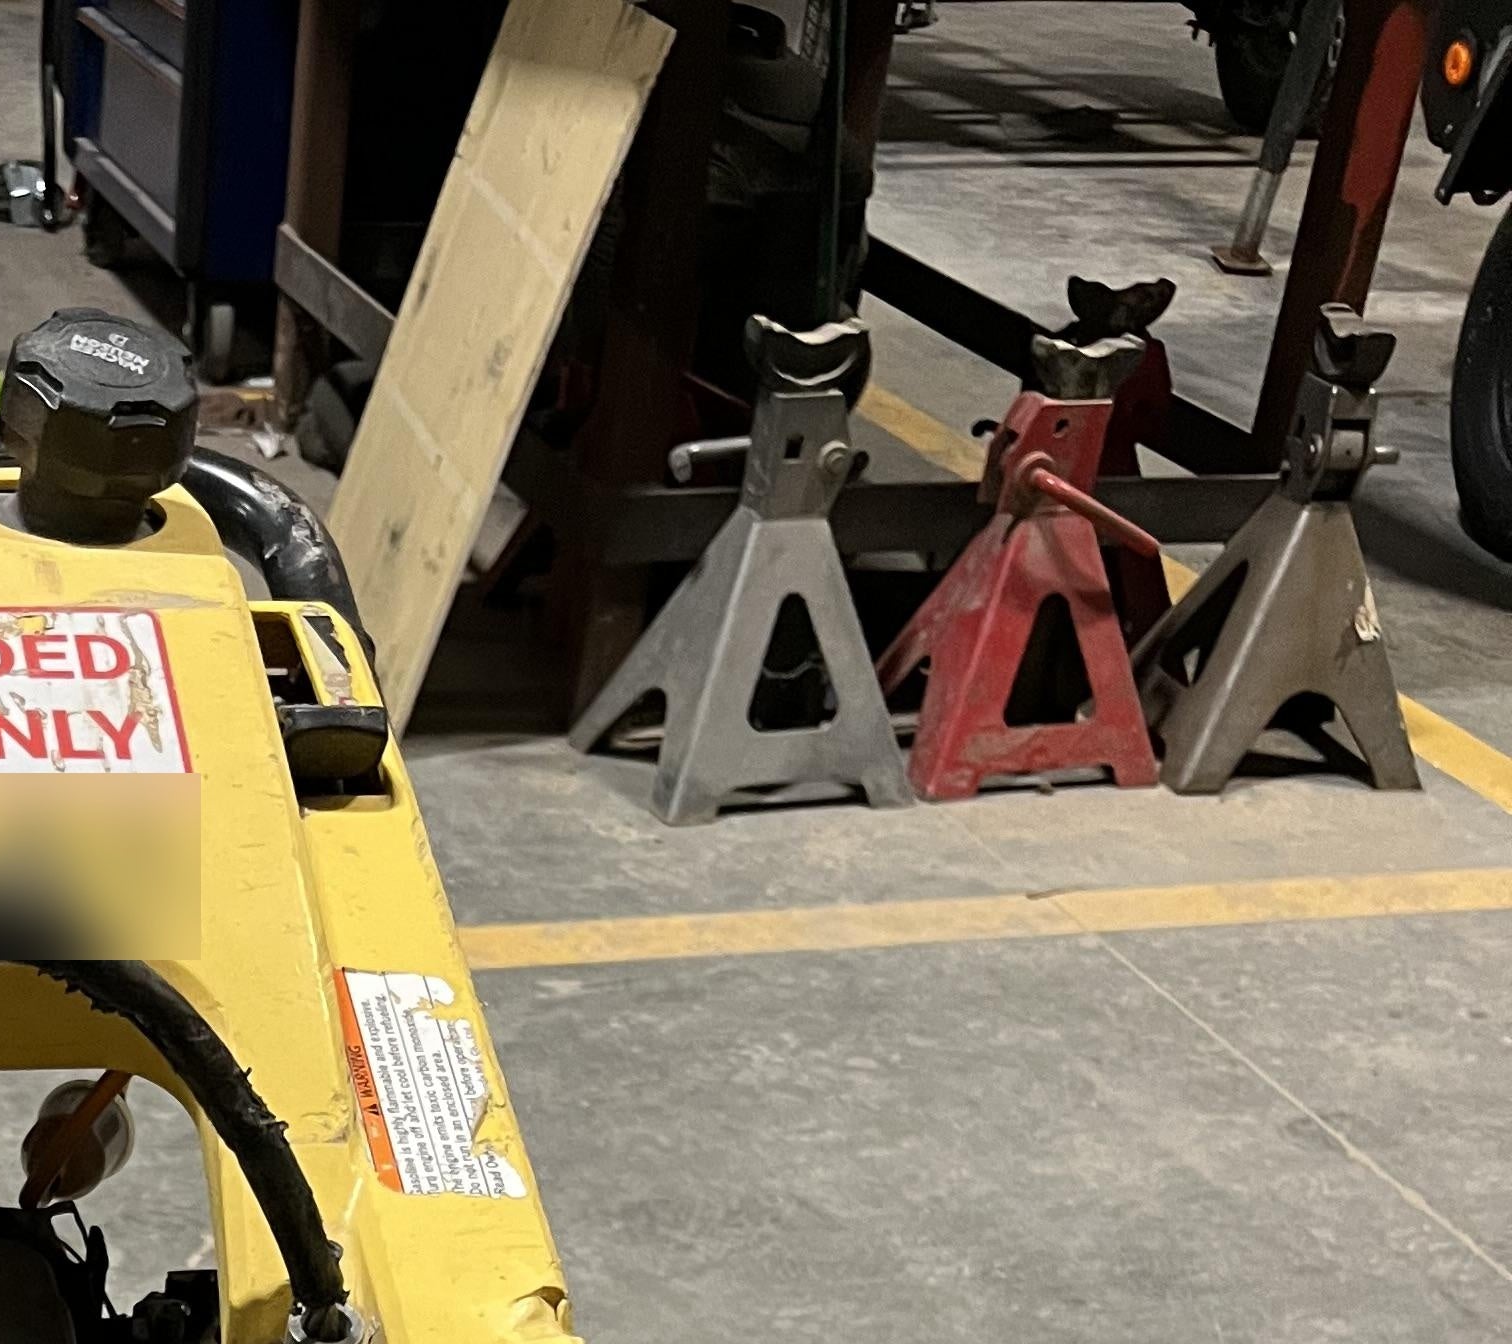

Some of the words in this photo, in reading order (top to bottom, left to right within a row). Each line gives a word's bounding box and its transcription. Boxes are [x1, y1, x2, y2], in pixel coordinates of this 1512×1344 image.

[388, 1037, 404, 1066] before
[348, 1045, 373, 1098] WARNING
[394, 1069, 410, 1089] cool
